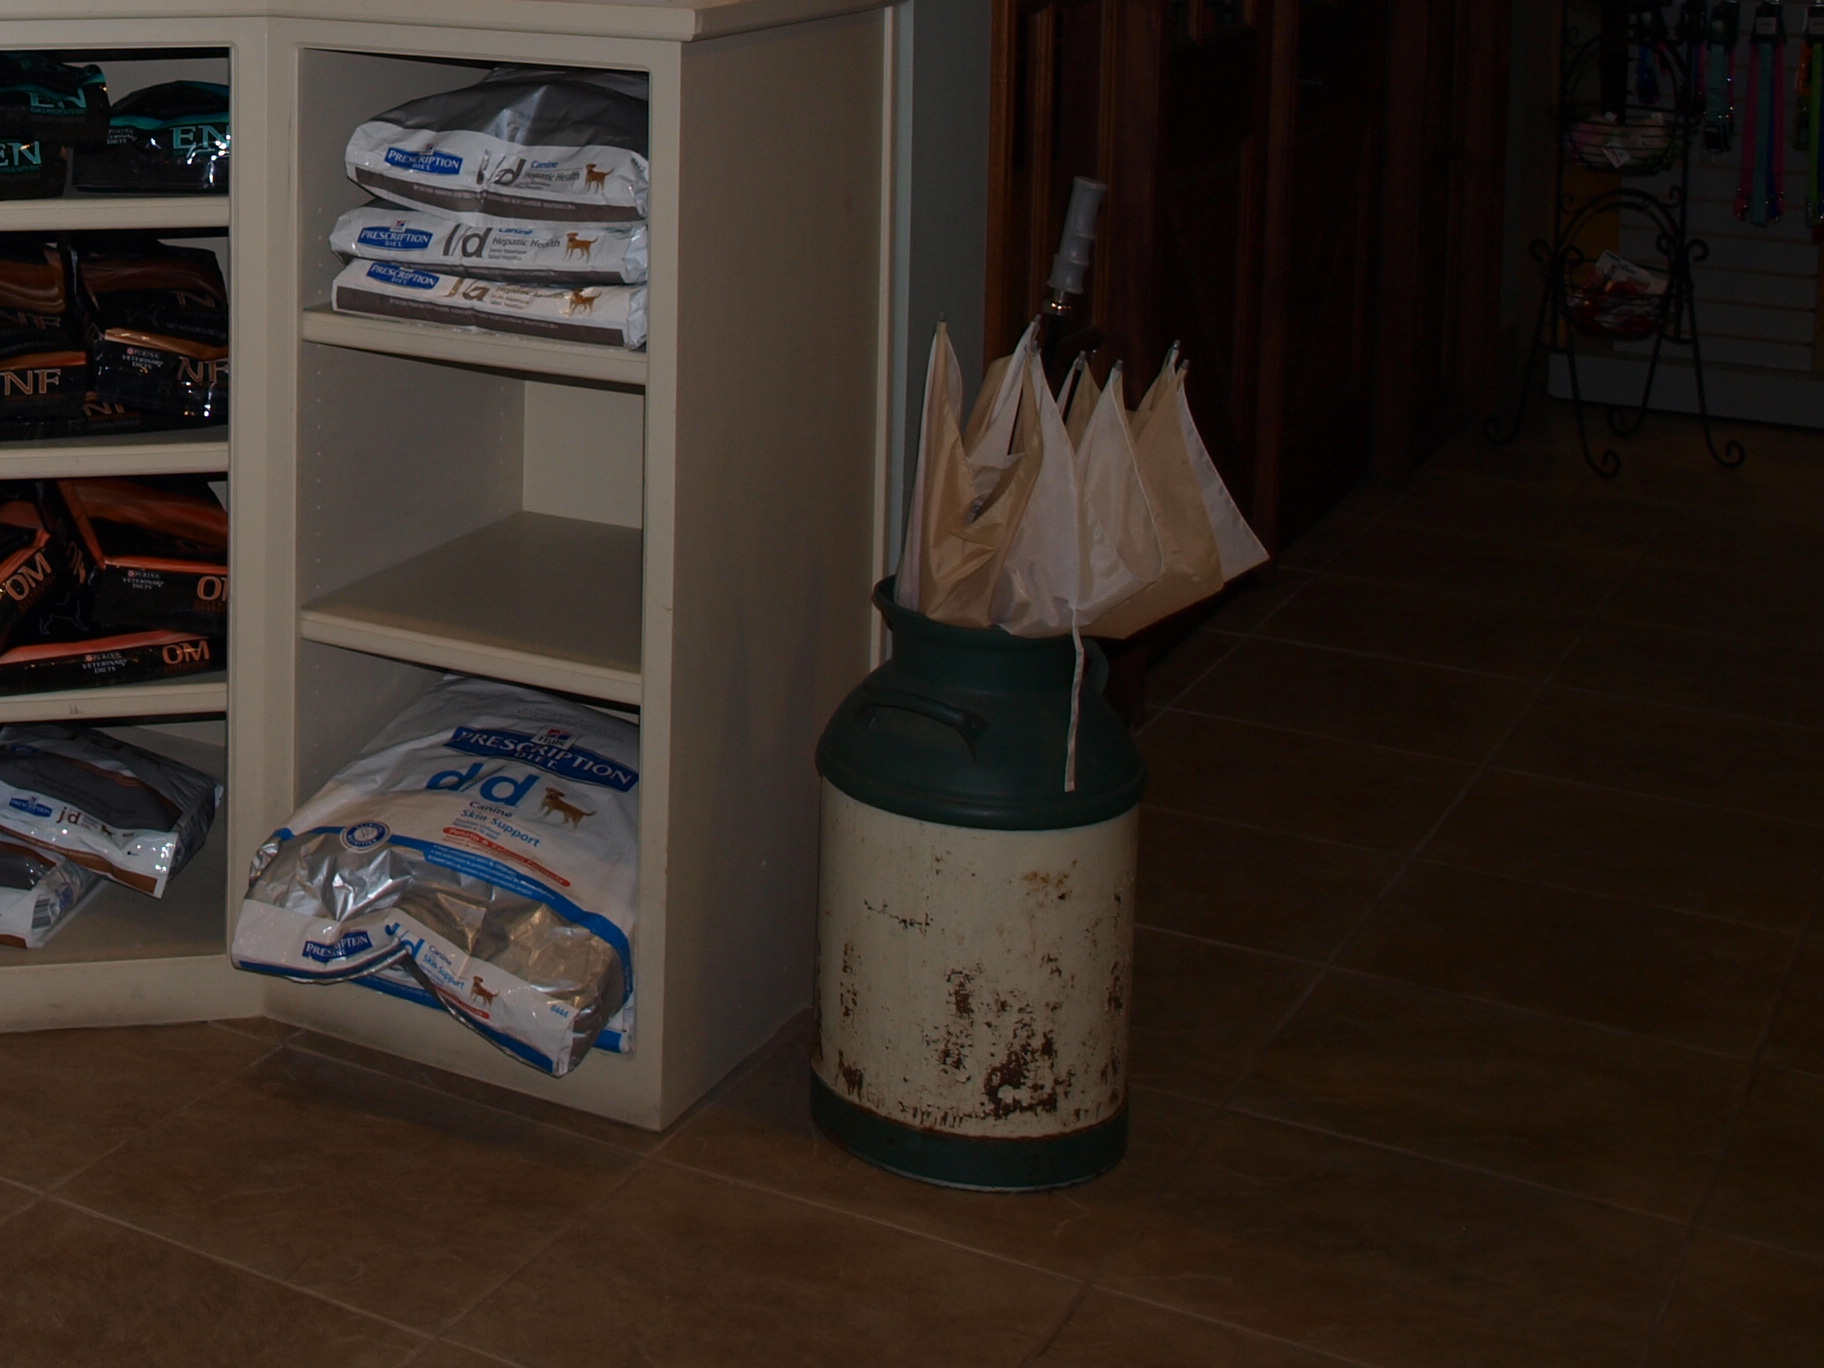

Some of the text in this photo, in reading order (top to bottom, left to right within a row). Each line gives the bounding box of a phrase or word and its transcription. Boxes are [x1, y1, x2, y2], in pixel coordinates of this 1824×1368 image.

[388, 149, 460, 170] PRESCRIPTION
[530, 160, 558, 169] Canine
[360, 231, 430, 244] PRESCRIPTION
[491, 236, 527, 248] Hepatic
[370, 264, 439, 286] PRESCRIPTION
[176, 354, 229, 382] NF
[4, 550, 53, 602] OM
[162, 639, 211, 666] OM
[456, 729, 633, 786] PRESCRIPTION
[514, 748, 559, 770] DIET
[426, 762, 540, 808] d/d
[469, 800, 514, 819] Canine
[460, 808, 542, 848] Skin Support
[428, 944, 454, 966] Canine
[422, 953, 465, 990] Skin Support
